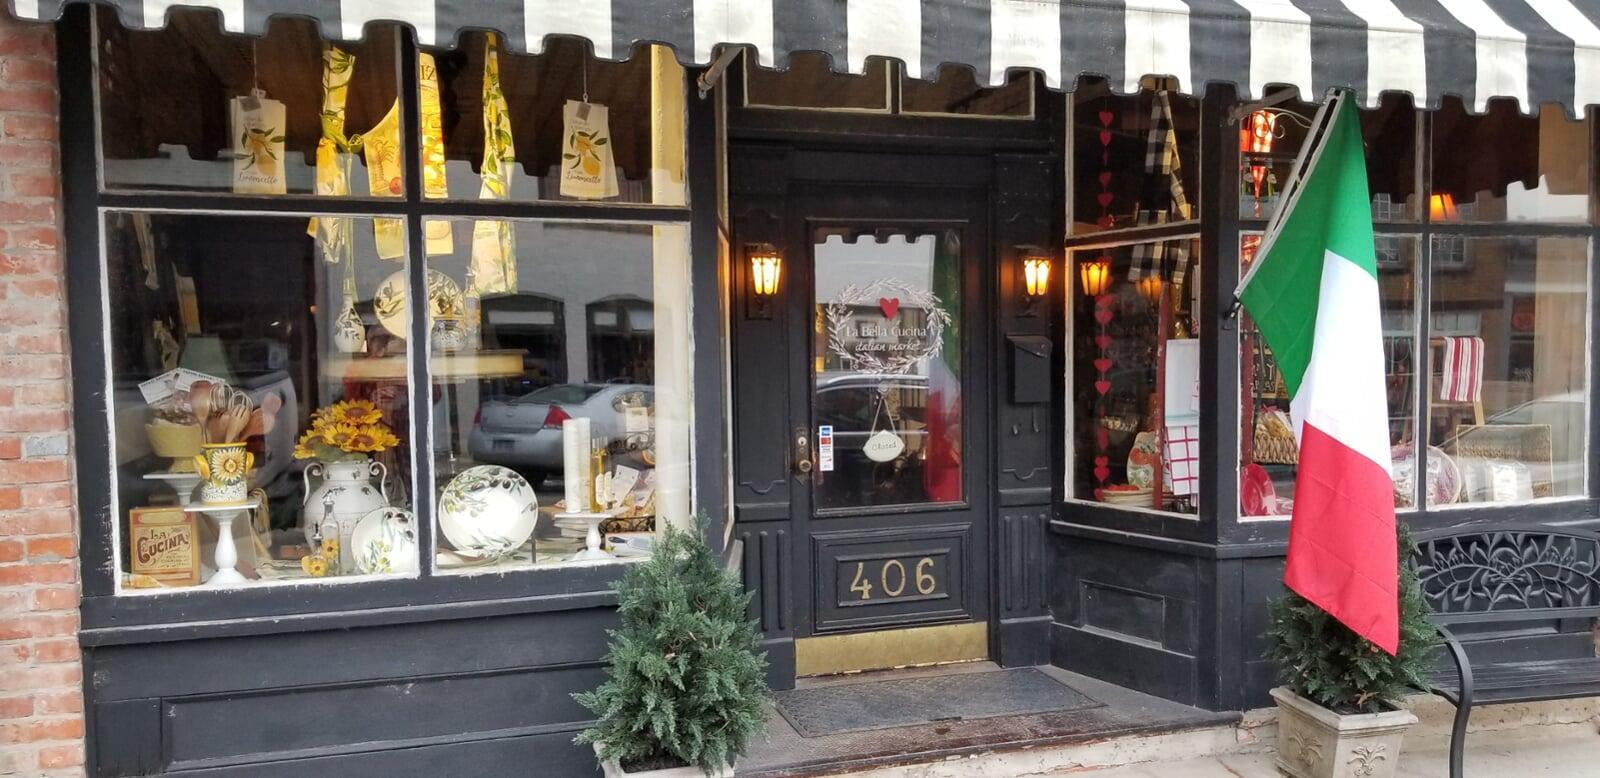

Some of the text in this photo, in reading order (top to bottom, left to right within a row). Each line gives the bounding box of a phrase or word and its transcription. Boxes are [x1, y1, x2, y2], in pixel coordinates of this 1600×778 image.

[846, 321, 927, 337] La Bella Cucina
[855, 338, 921, 352] italian market
[850, 557, 936, 600] 406
